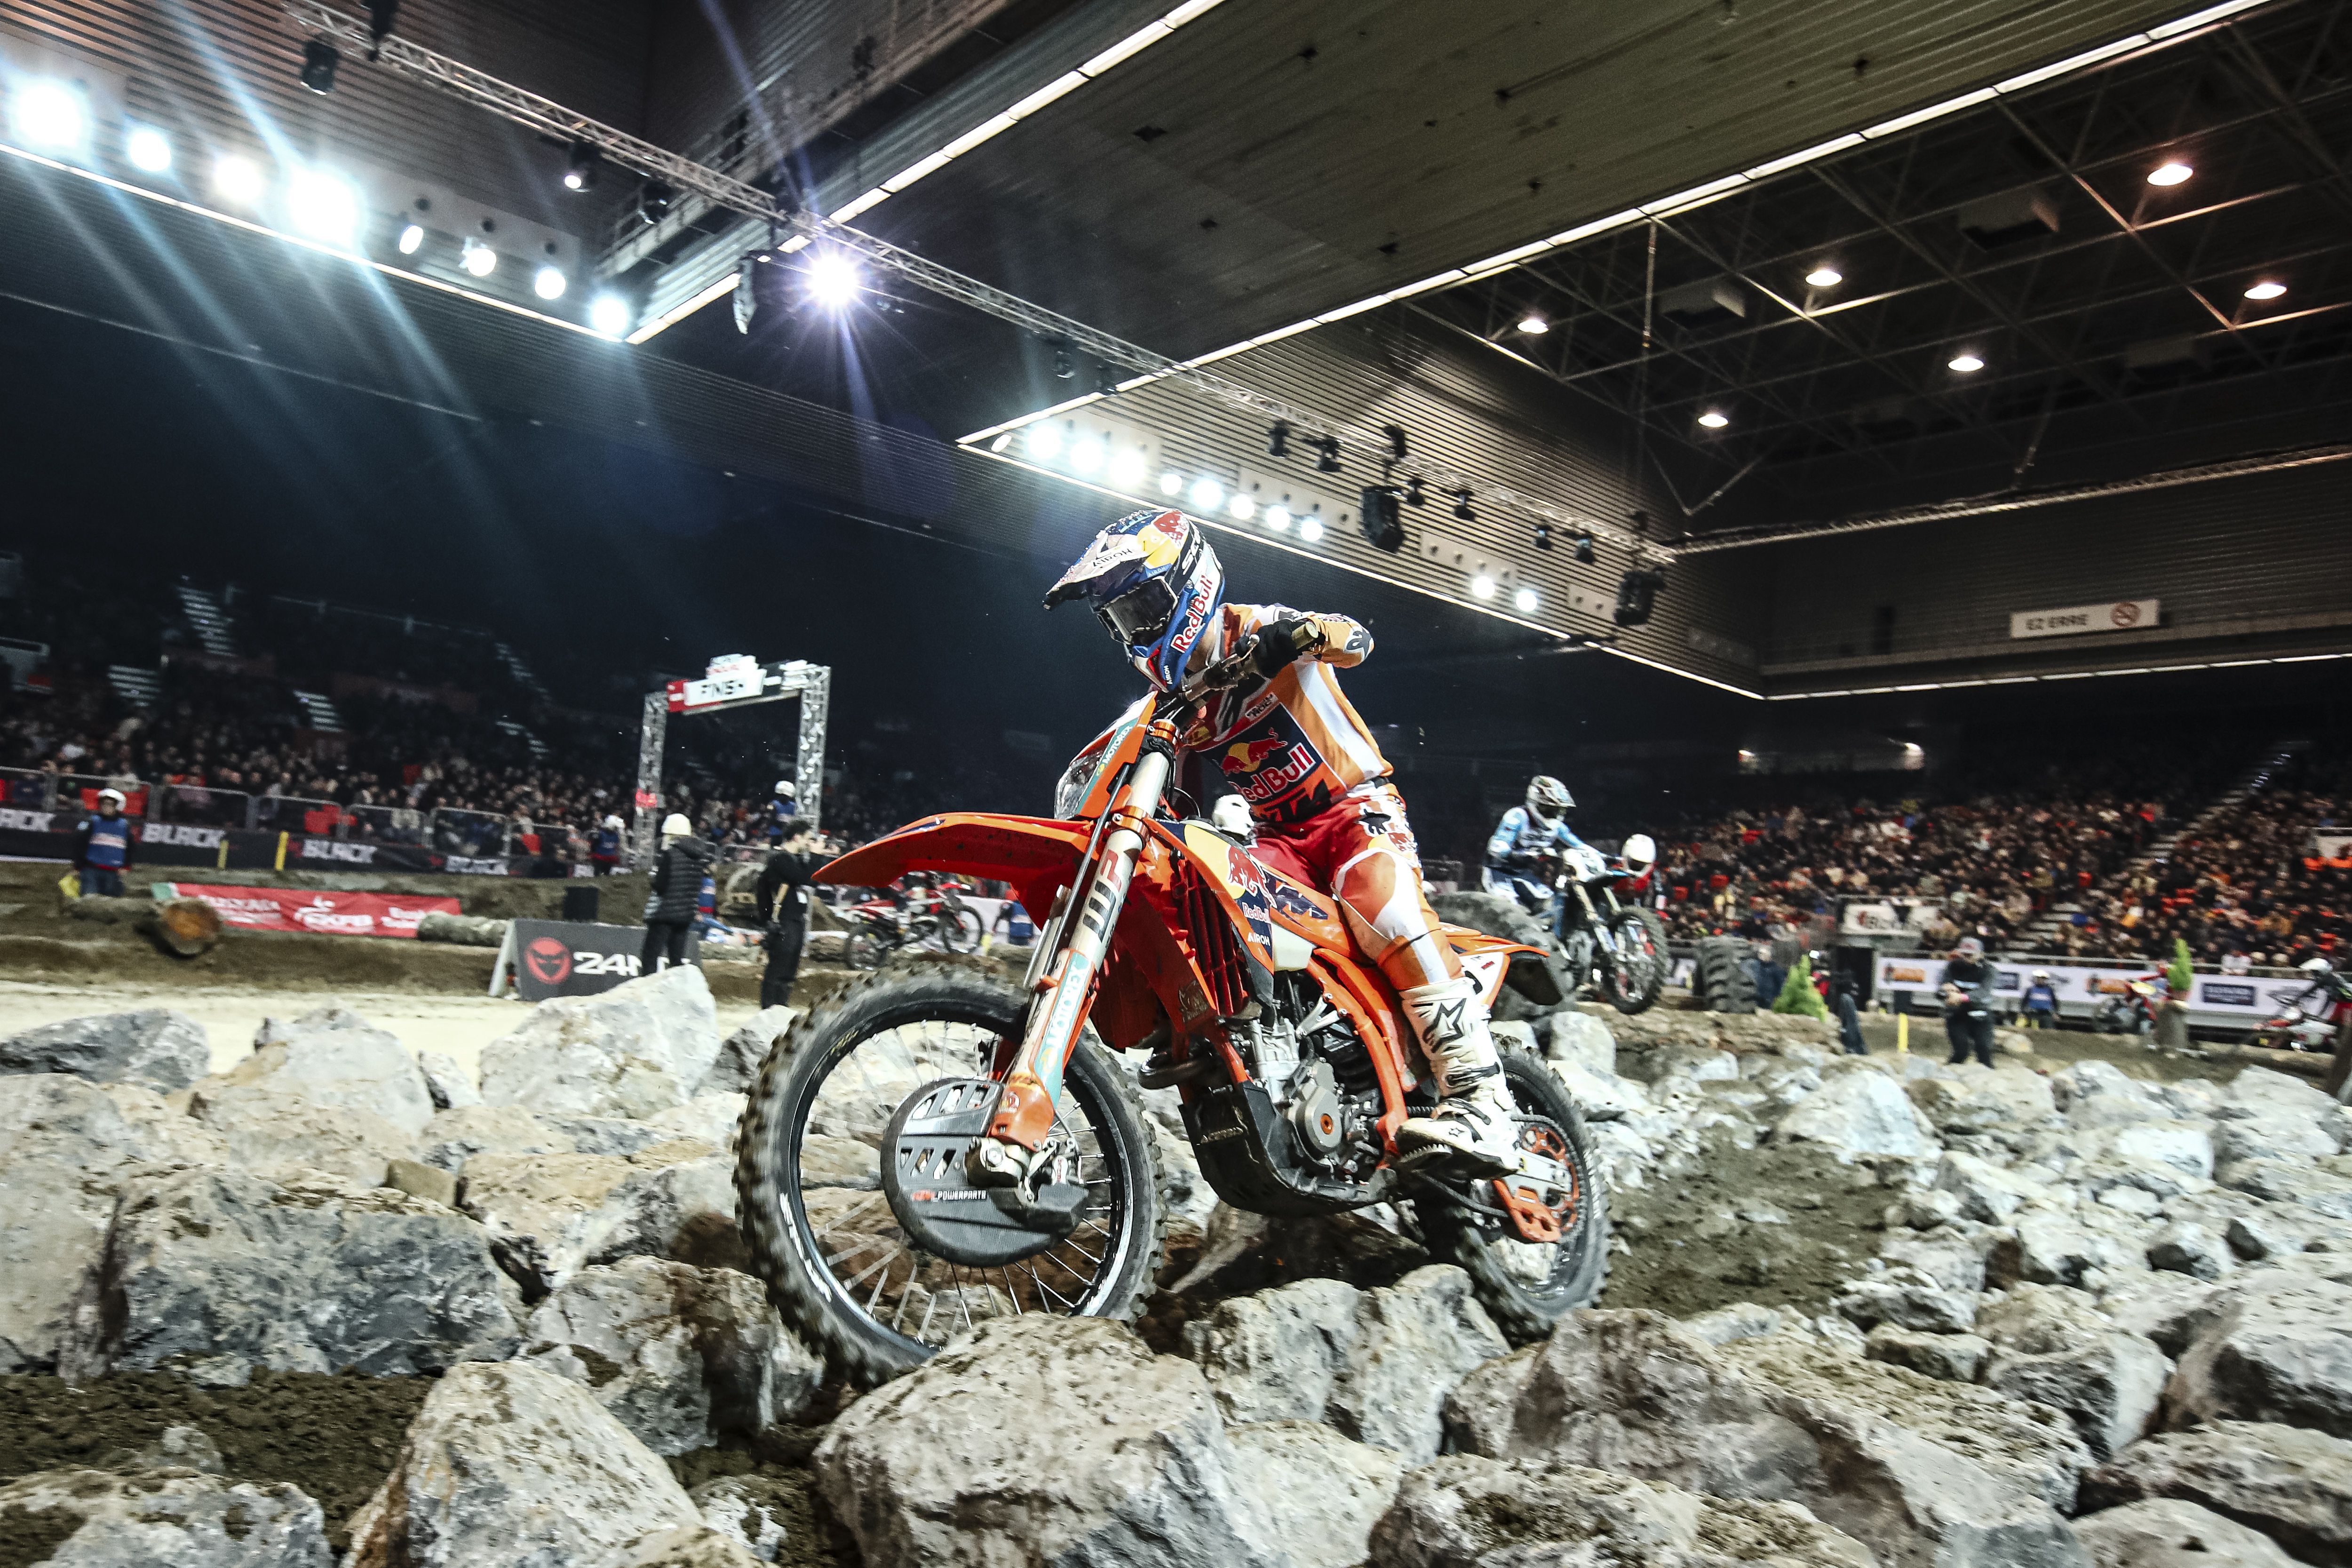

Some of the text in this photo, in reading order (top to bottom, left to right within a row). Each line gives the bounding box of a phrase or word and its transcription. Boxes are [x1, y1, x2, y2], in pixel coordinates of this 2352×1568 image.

[1092, 549, 1133, 567] AIROH
[1148, 566, 1167, 577] AIROH
[1102, 725, 1134, 764] MOTOREX
[142, 822, 225, 848] BLACK
[303, 839, 377, 863] BLACK
[1248, 933, 1271, 946] AIROH
[1046, 963, 1089, 1048] MOTOREX
[938, 1190, 986, 1200] POWERPARTS
